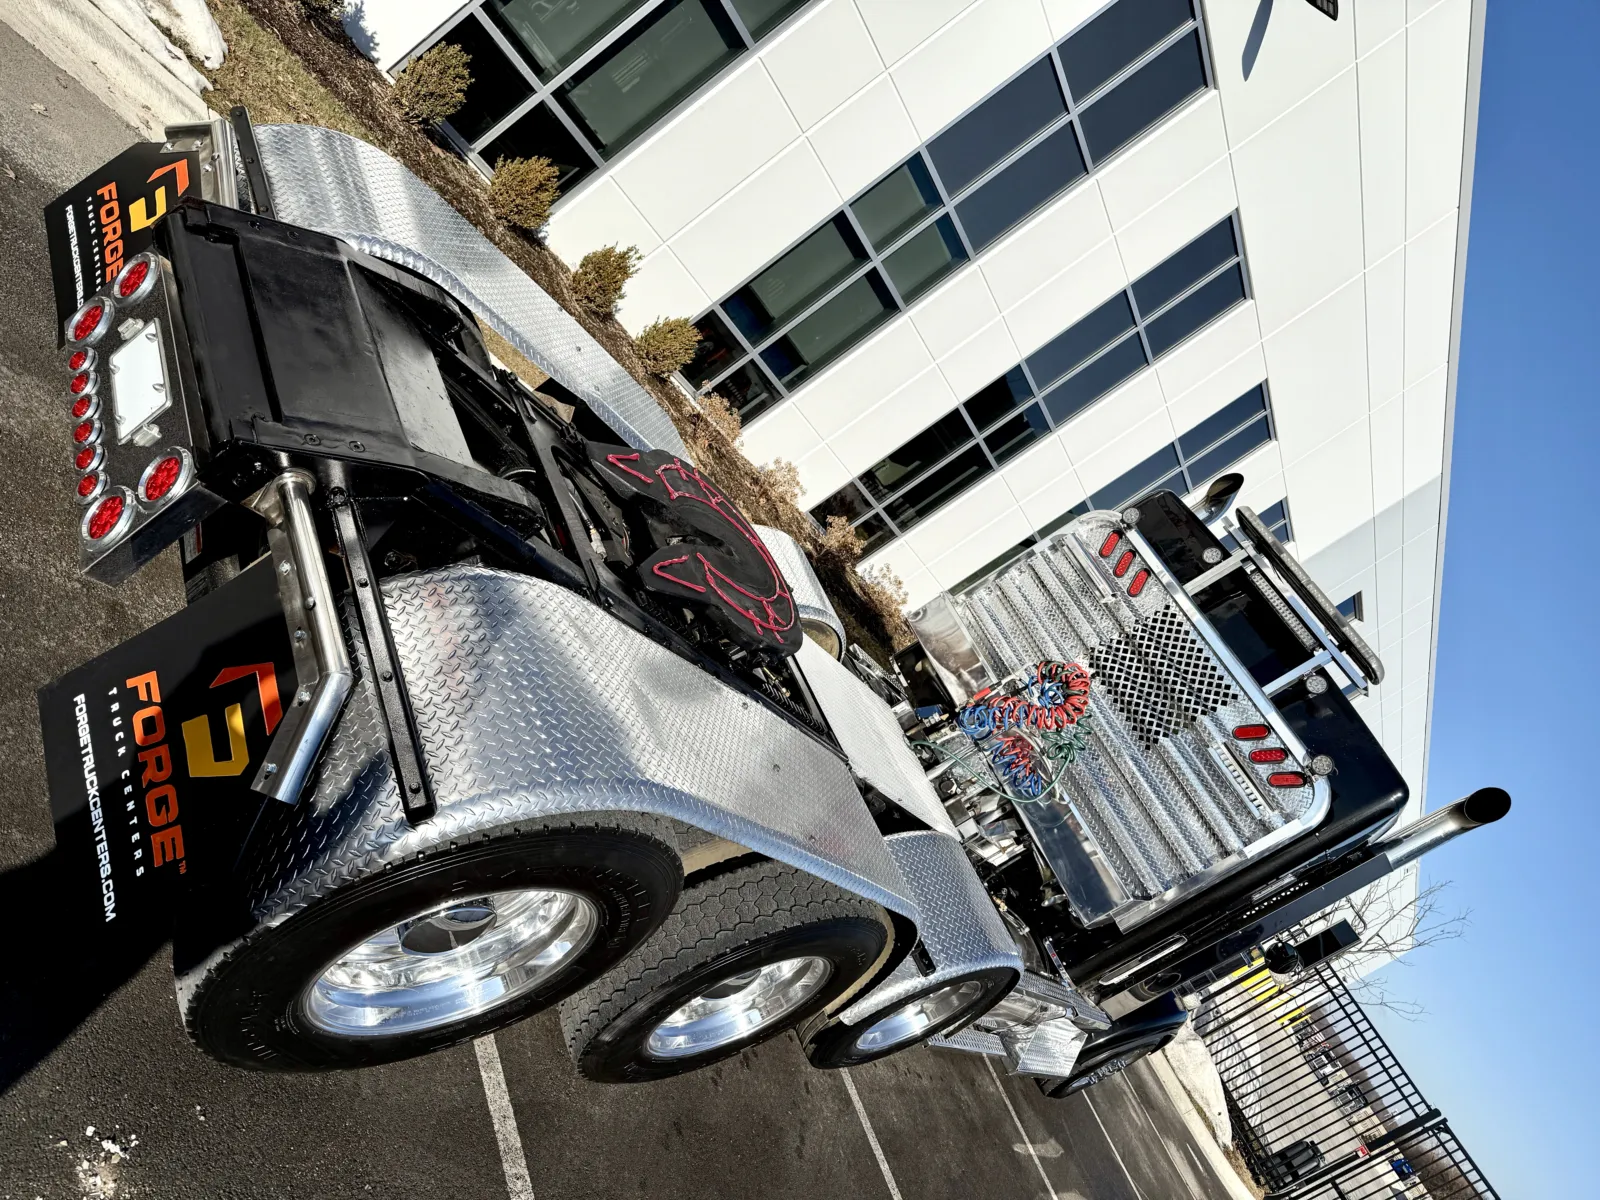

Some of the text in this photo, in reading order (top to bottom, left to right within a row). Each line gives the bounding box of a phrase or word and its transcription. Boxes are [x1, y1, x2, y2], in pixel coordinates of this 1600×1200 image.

[65, 204, 85, 310] FORGETRUCKCENTERS.C
[86, 196, 102, 292] TRUCK CENTERS
[96, 181, 124, 283] FORGE
[73, 692, 117, 923] FORGETRUCKCENTERS.COM
[107, 686, 145, 877] TRUCK CENTERS
[126, 670, 185, 868] FORGE
